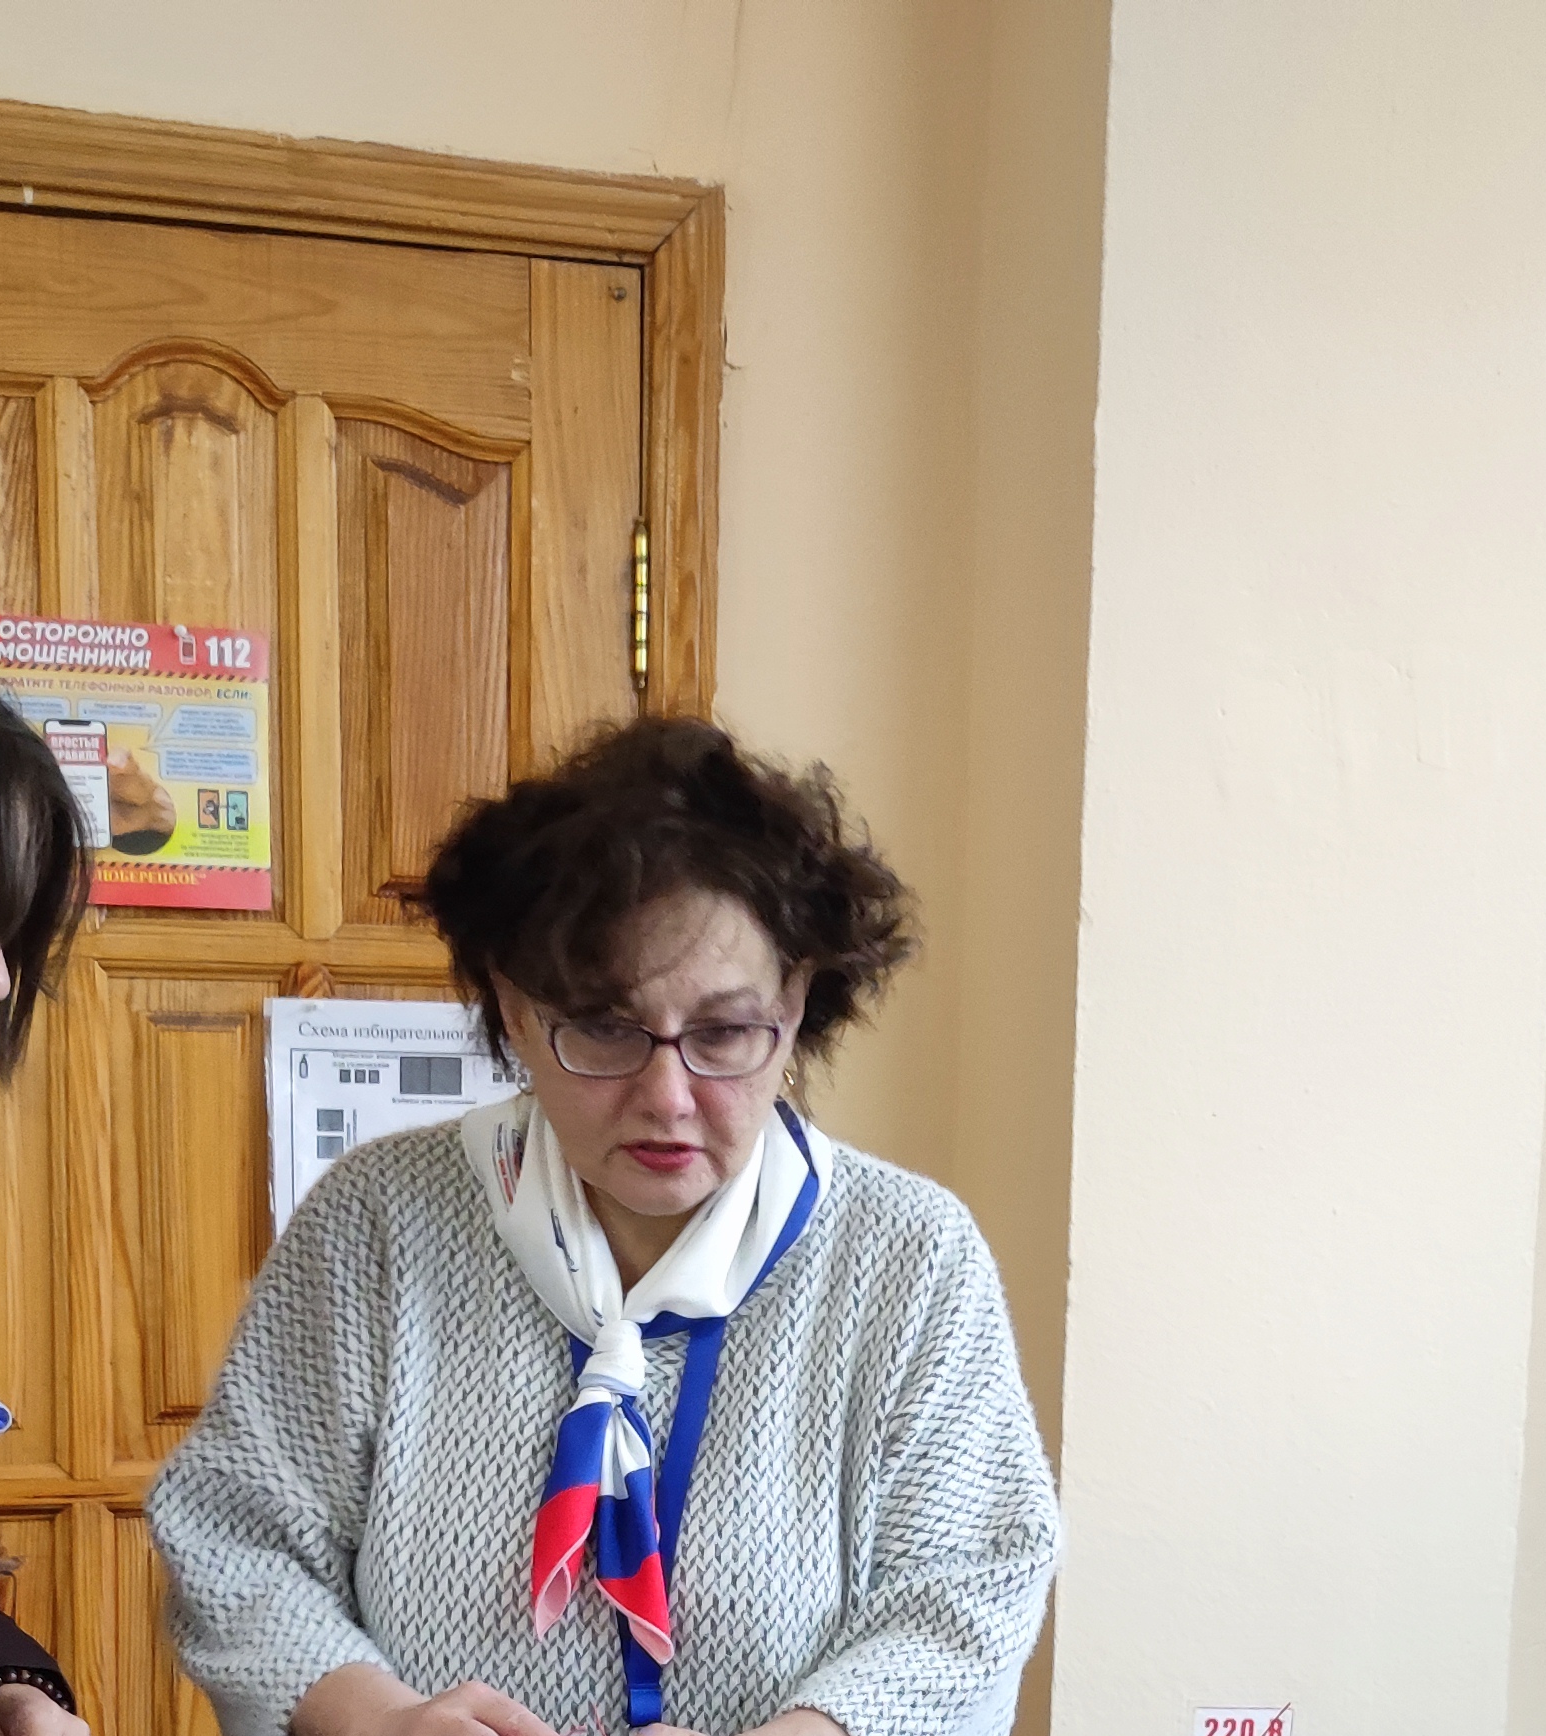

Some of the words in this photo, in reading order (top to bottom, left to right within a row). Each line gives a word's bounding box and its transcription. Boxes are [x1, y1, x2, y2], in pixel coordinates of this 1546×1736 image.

[204, 636, 251, 669] 112
[59, 679, 145, 696] ТЕЛЕФОННЫЙ
[298, 1021, 349, 1039] Схема
